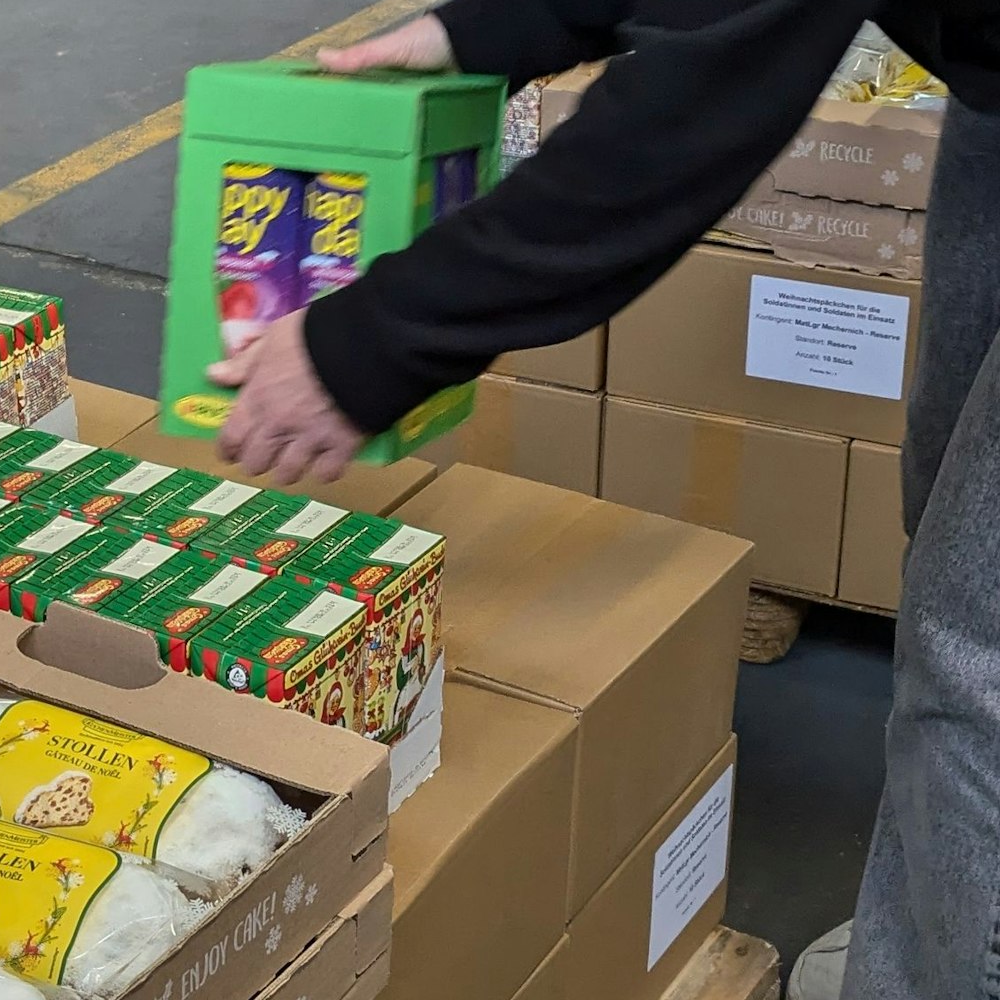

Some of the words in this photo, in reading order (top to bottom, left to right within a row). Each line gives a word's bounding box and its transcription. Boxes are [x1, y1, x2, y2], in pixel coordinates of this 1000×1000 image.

[819, 141, 874, 164] RECYCLE
[747, 208, 785, 228] CAKE!
[817, 216, 870, 239] RECYCLE
[763, 298, 806, 311] Soldatinnen
[807, 305, 822, 313] und
[823, 307, 856, 318] Soldaten
[868, 313, 896, 324] Einsatz
[778, 292, 855, 310] Weihnachtspäckchen
[868, 306, 881, 314] die
[822, 322, 864, 336] Mechernich
[870, 330, 901, 341] Reserve
[826, 339, 857, 350] Reserve
[833, 356, 854, 366] Stück
[378, 585, 399, 607] Omas
[290, 660, 312, 683] Omas
[45, 749, 82, 767] GÂTEAU
[82, 763, 97, 773] DE
[96, 767, 122, 780] NOËL
[47, 735, 139, 771] STOLLEN
[181, 934, 229, 1000] ENJOY
[233, 891, 277, 951] CAKE!
